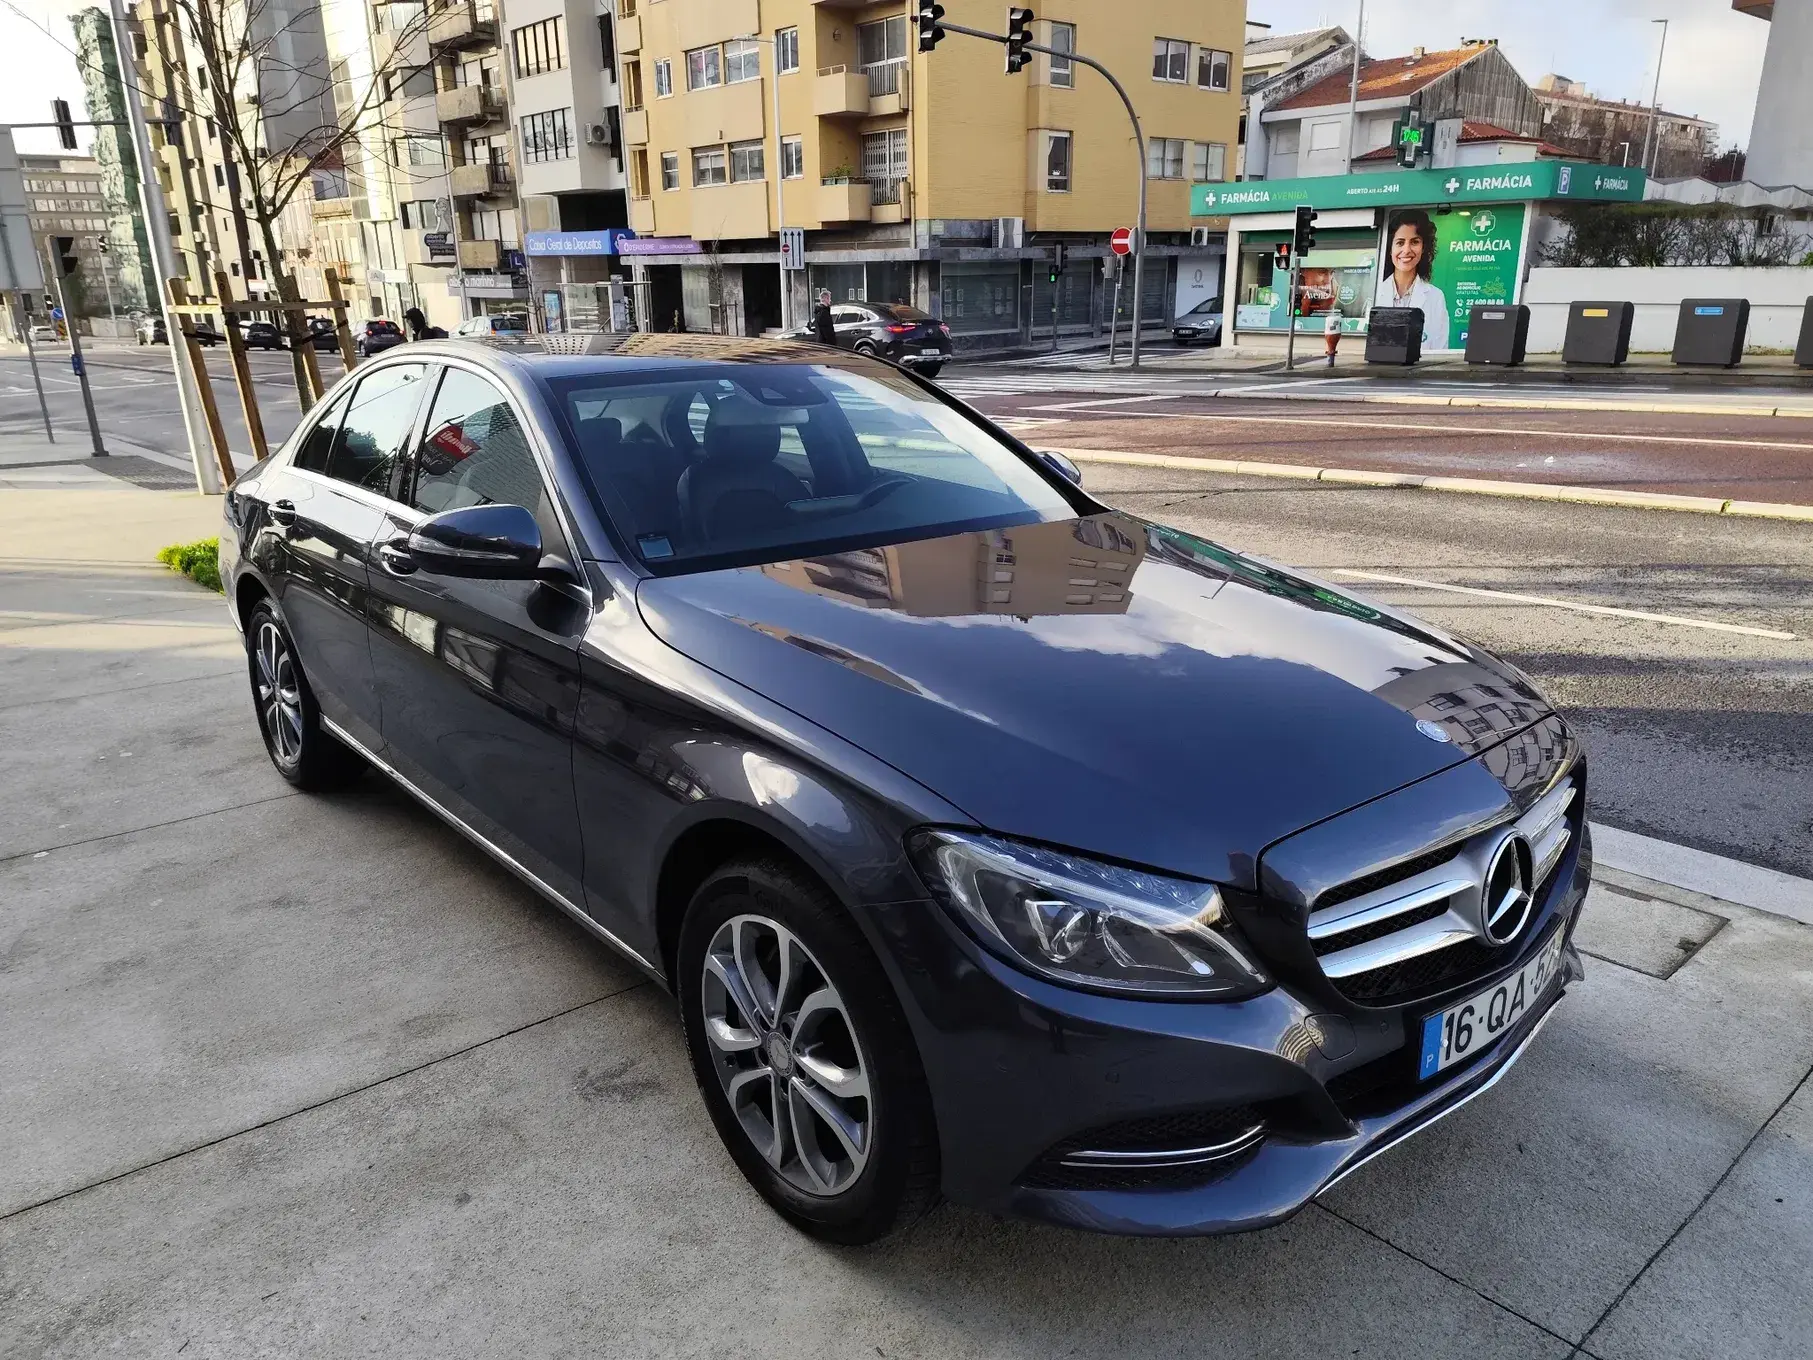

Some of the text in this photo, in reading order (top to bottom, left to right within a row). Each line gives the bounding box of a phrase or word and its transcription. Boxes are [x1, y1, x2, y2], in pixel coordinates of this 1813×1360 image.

[1382, 184, 1399, 193] 24H
[1467, 173, 1532, 190] FARMÁCIA
[1602, 176, 1628, 191] FARMÁCIA
[1221, 189, 1309, 204] FARMÁCIA AVENIDA
[546, 237, 563, 250] Geral
[564, 238, 572, 250] de
[1449, 238, 1512, 252] FARMÁCIA
[1462, 254, 1495, 262] AVENIDA
[1425, 1054, 1434, 1068] P
